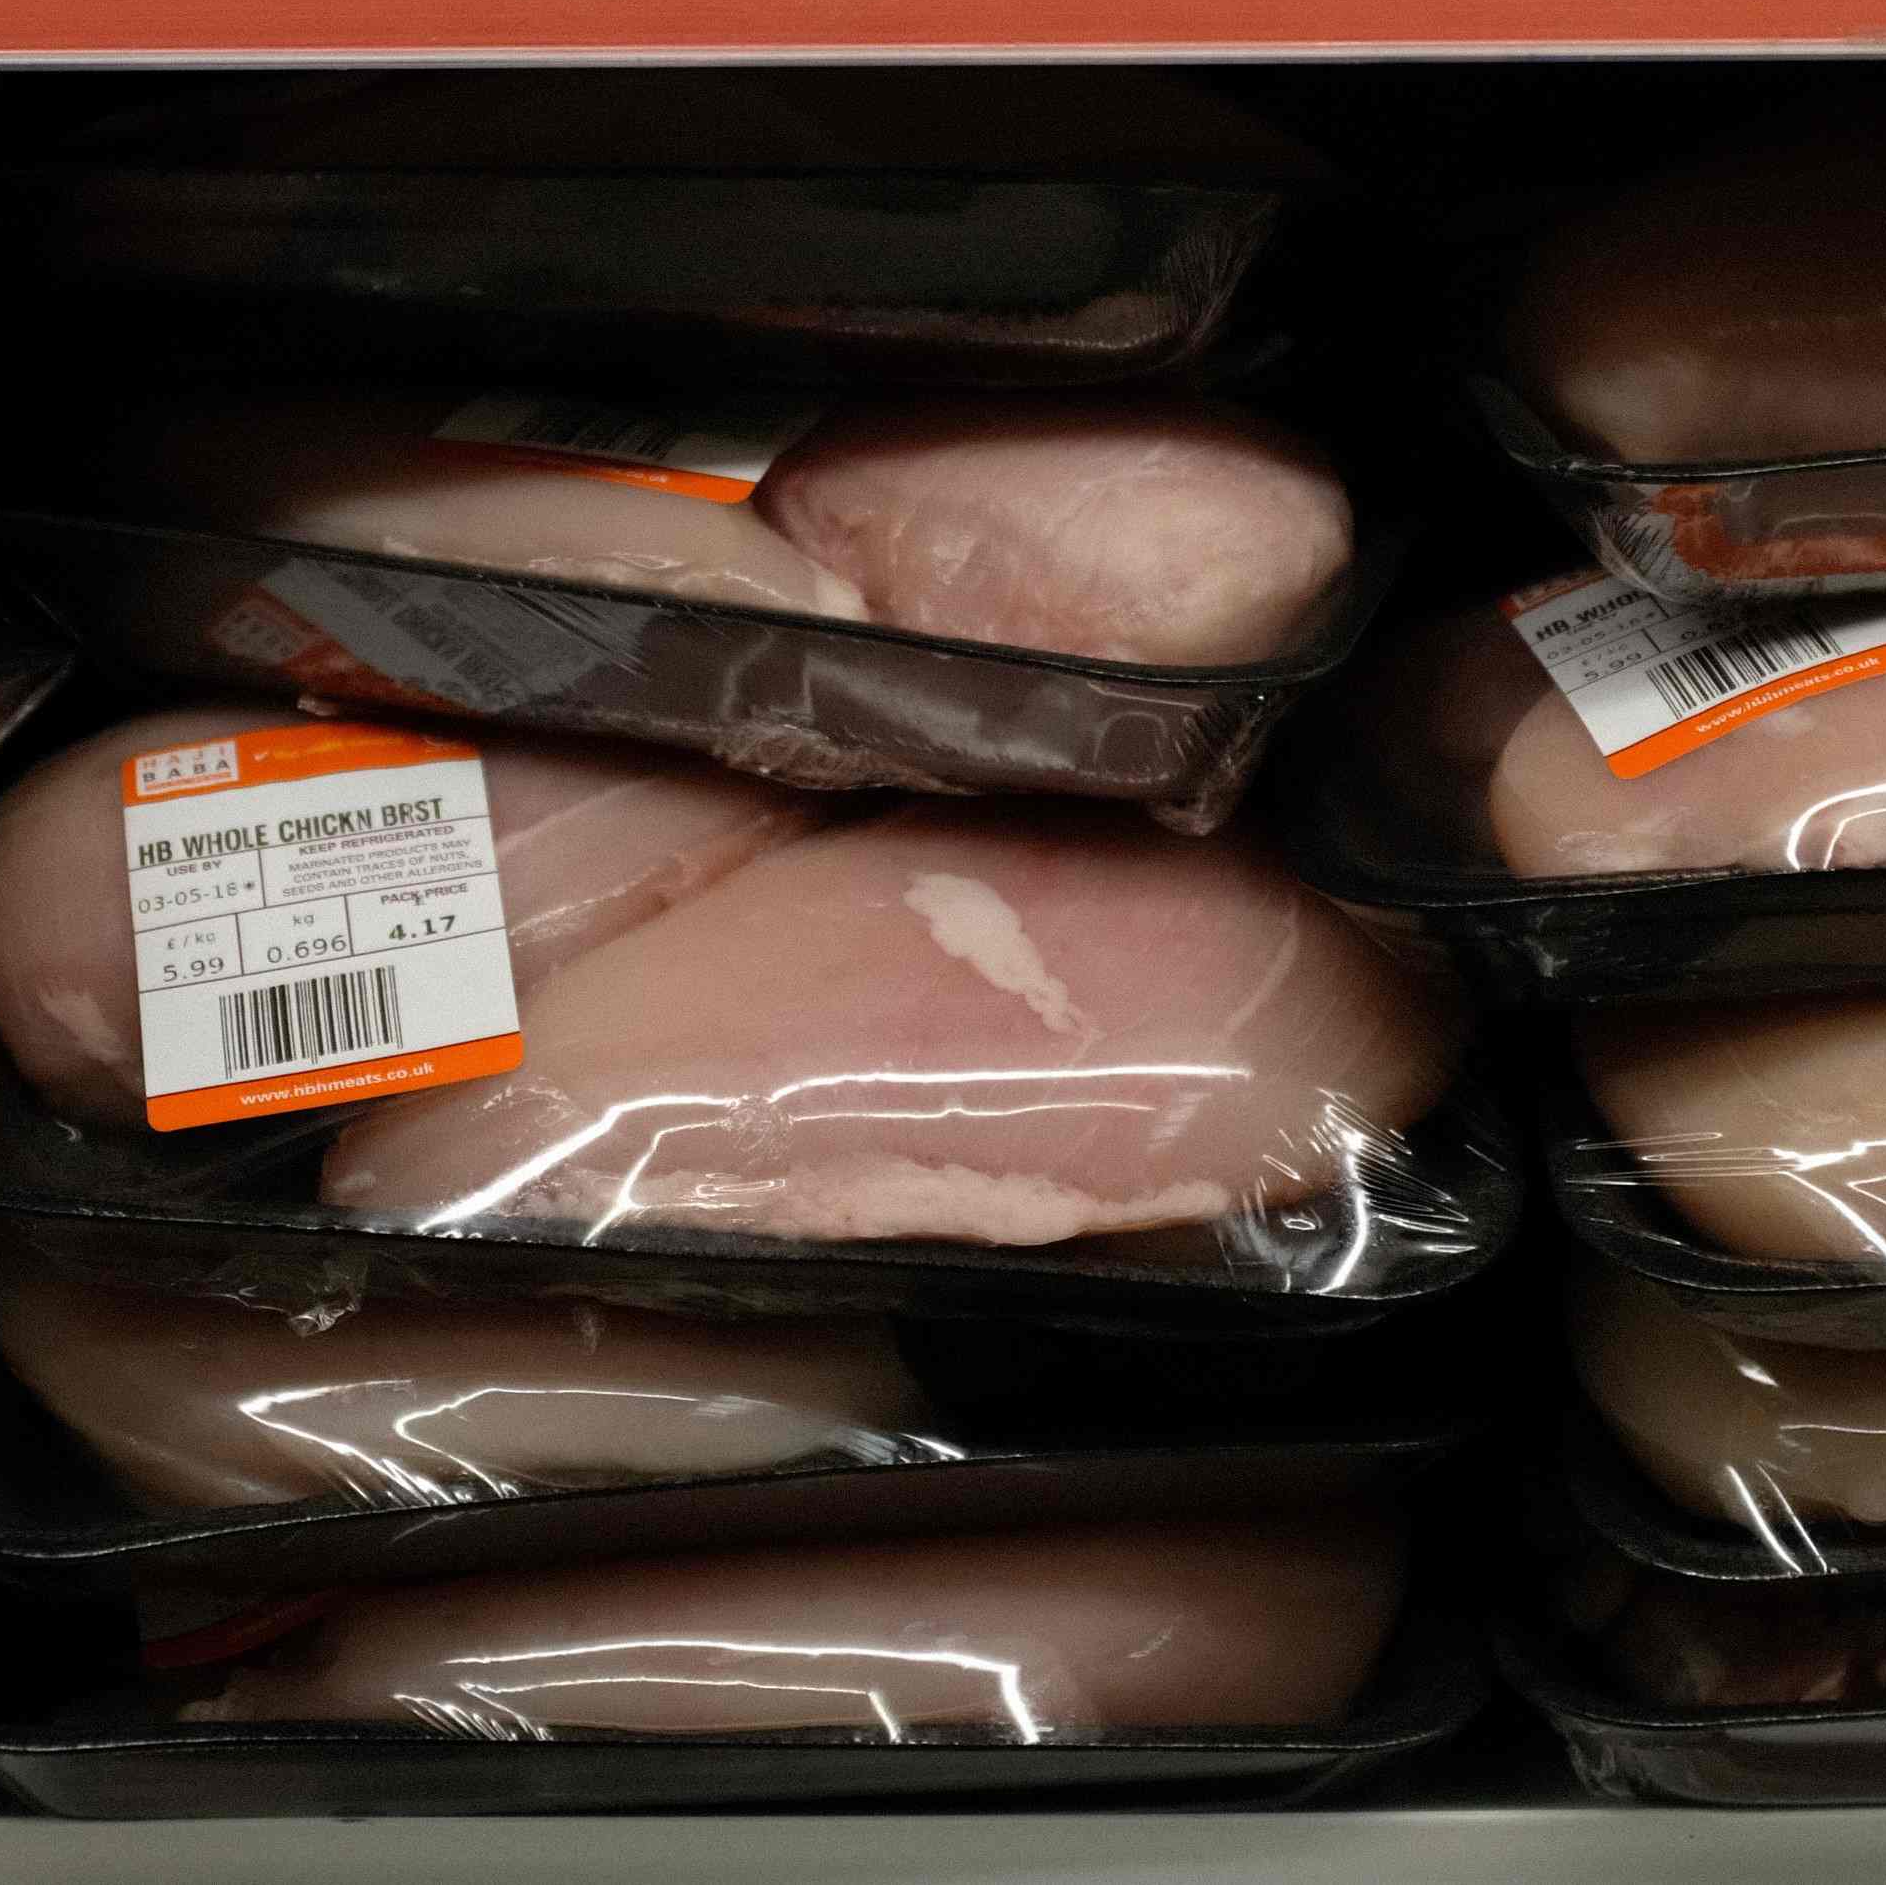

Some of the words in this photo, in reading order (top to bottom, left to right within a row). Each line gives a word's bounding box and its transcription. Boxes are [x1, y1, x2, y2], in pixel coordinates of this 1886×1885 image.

[143, 759, 231, 783] BABA
[138, 843, 173, 866] HB
[182, 825, 268, 859] WHOLE
[278, 808, 372, 843] CHICKN
[382, 798, 444, 826] BRST
[299, 842, 338, 856] KEEP
[340, 825, 455, 849] REFRIGERATED
[166, 862, 199, 877] USE
[202, 860, 223, 872] BY
[380, 892, 420, 906] PACK
[425, 884, 468, 899] PRICE
[389, 915, 456, 941] 4.17
[267, 935, 347, 964] 0.696
[162, 957, 224, 982] 5.99
